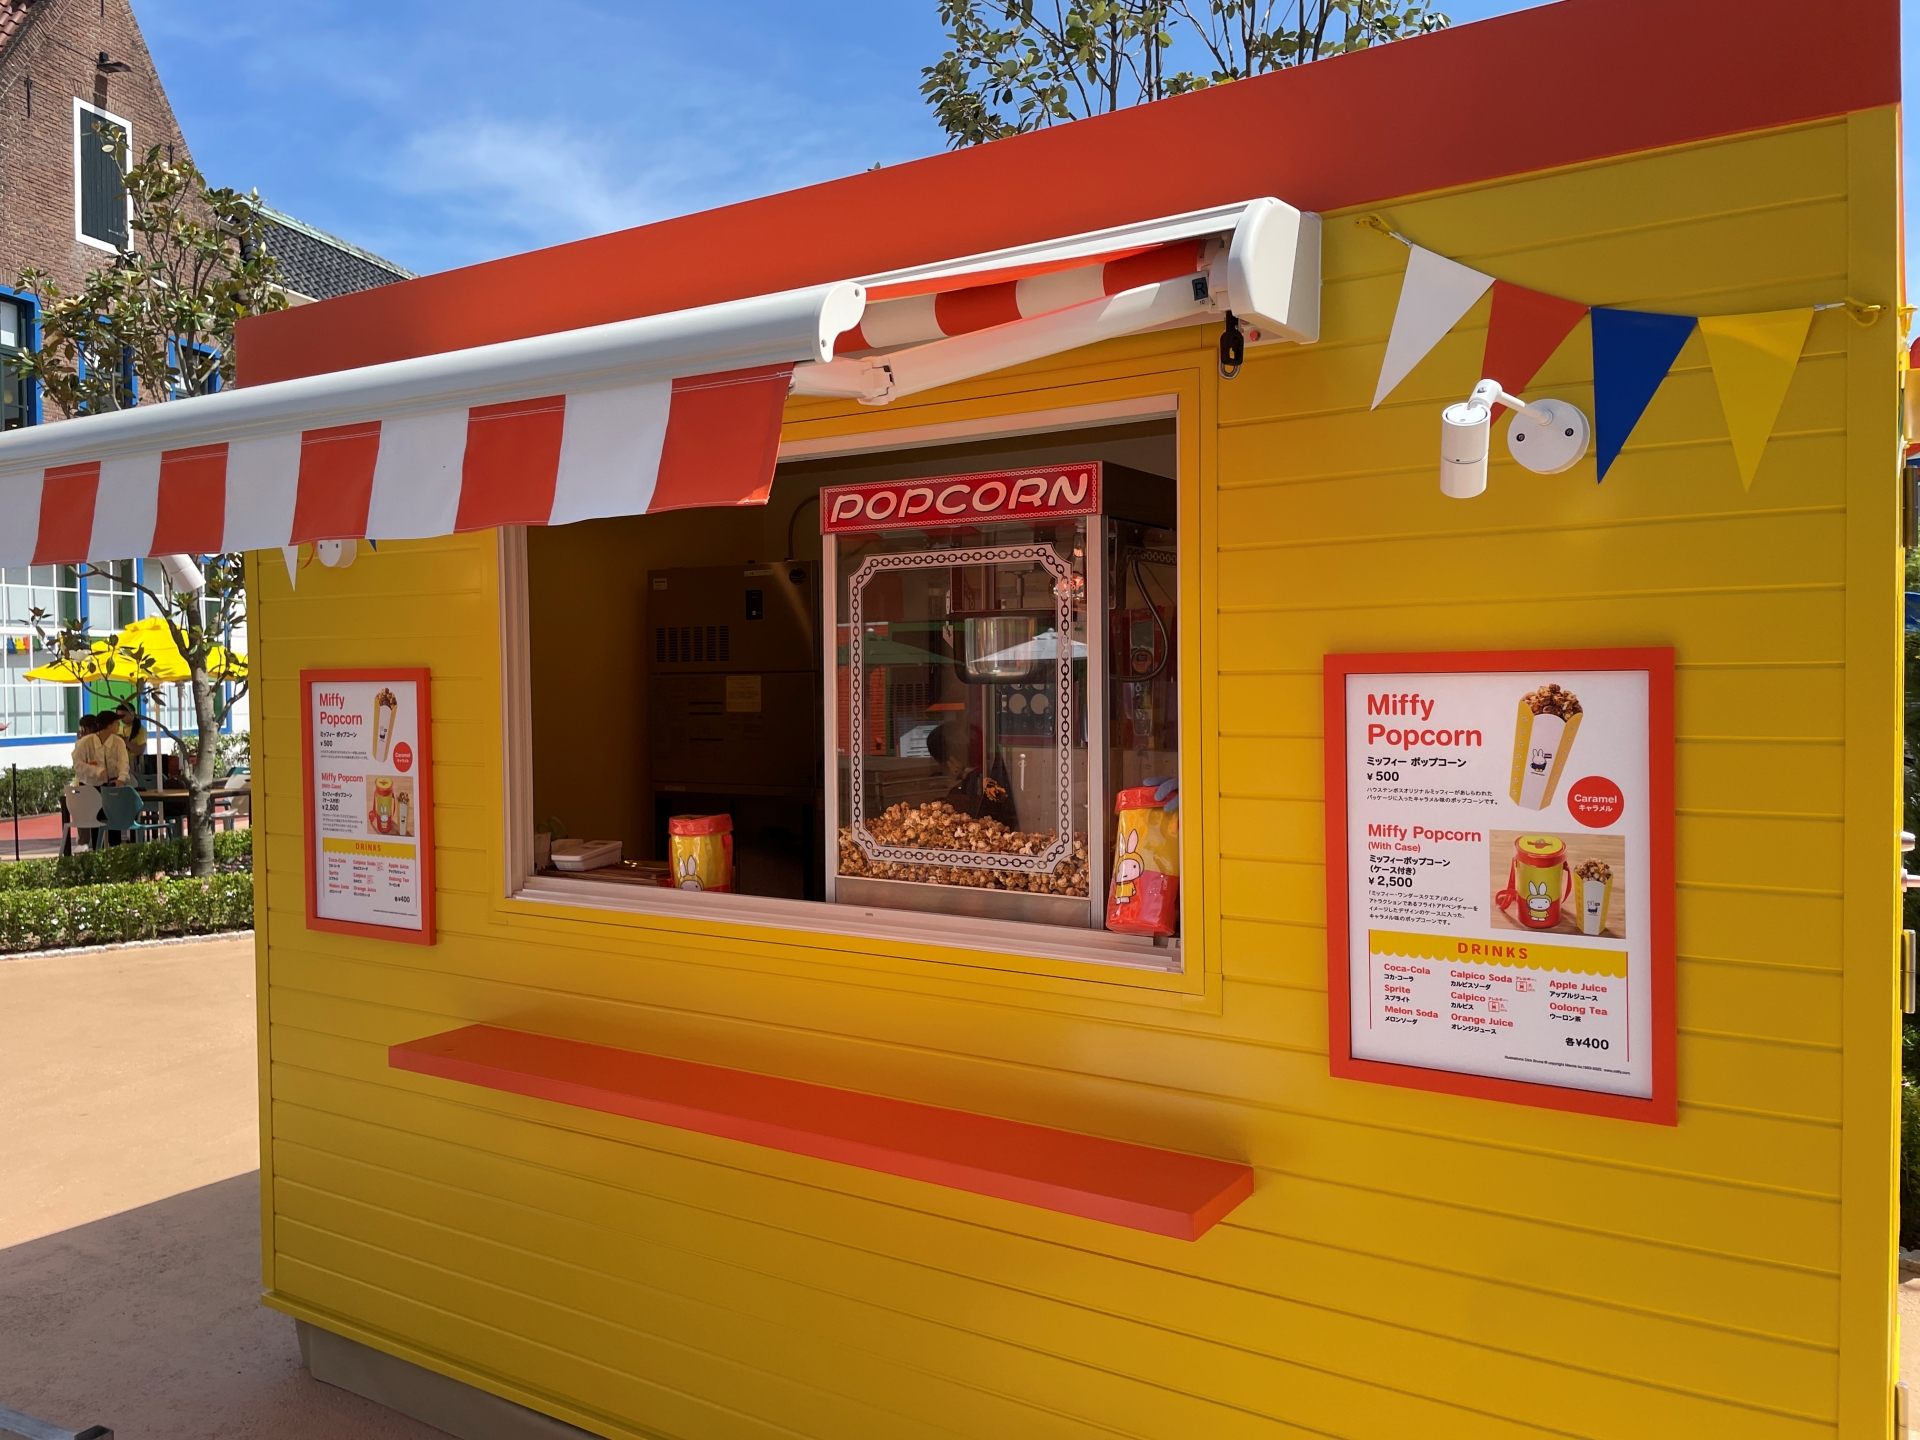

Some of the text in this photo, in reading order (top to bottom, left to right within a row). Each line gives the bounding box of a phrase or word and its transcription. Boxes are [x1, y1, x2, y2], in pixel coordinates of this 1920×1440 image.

[1195, 282, 1206, 297] R
[830, 472, 1088, 523] POPCORN
[319, 693, 345, 710] Miffy
[1367, 693, 1435, 721] Miffy
[319, 711, 363, 728] Popcorn
[1368, 723, 1482, 751] Popcorn
[1367, 756, 1467, 767] ミッフィー ポップコーン
[321, 772, 364, 784] Miffy Popcorn
[1367, 771, 1399, 782] ¥ 500
[1574, 794, 1617, 804] Caramel
[1368, 823, 1481, 843] Miffy Popcorn
[355, 842, 382, 852] DRINKS
[1368, 841, 1421, 853] (With Case)
[1369, 854, 1451, 867] ミッフィーポップコーン
[1377, 875, 1413, 888] 2,500
[1457, 942, 1528, 960] DRINKS
[1384, 963, 1431, 975] Coca-Cola
[1450, 970, 1513, 983] Calpico Soda
[1384, 984, 1411, 995] Sprite
[1549, 980, 1608, 993] Apple Juice
[1450, 991, 1486, 1002] Calpico
[1384, 1005, 1439, 1019] Melon Soda
[1549, 1002, 1608, 1016] Oolong Tea
[1450, 1013, 1514, 1028] Orange Juice
